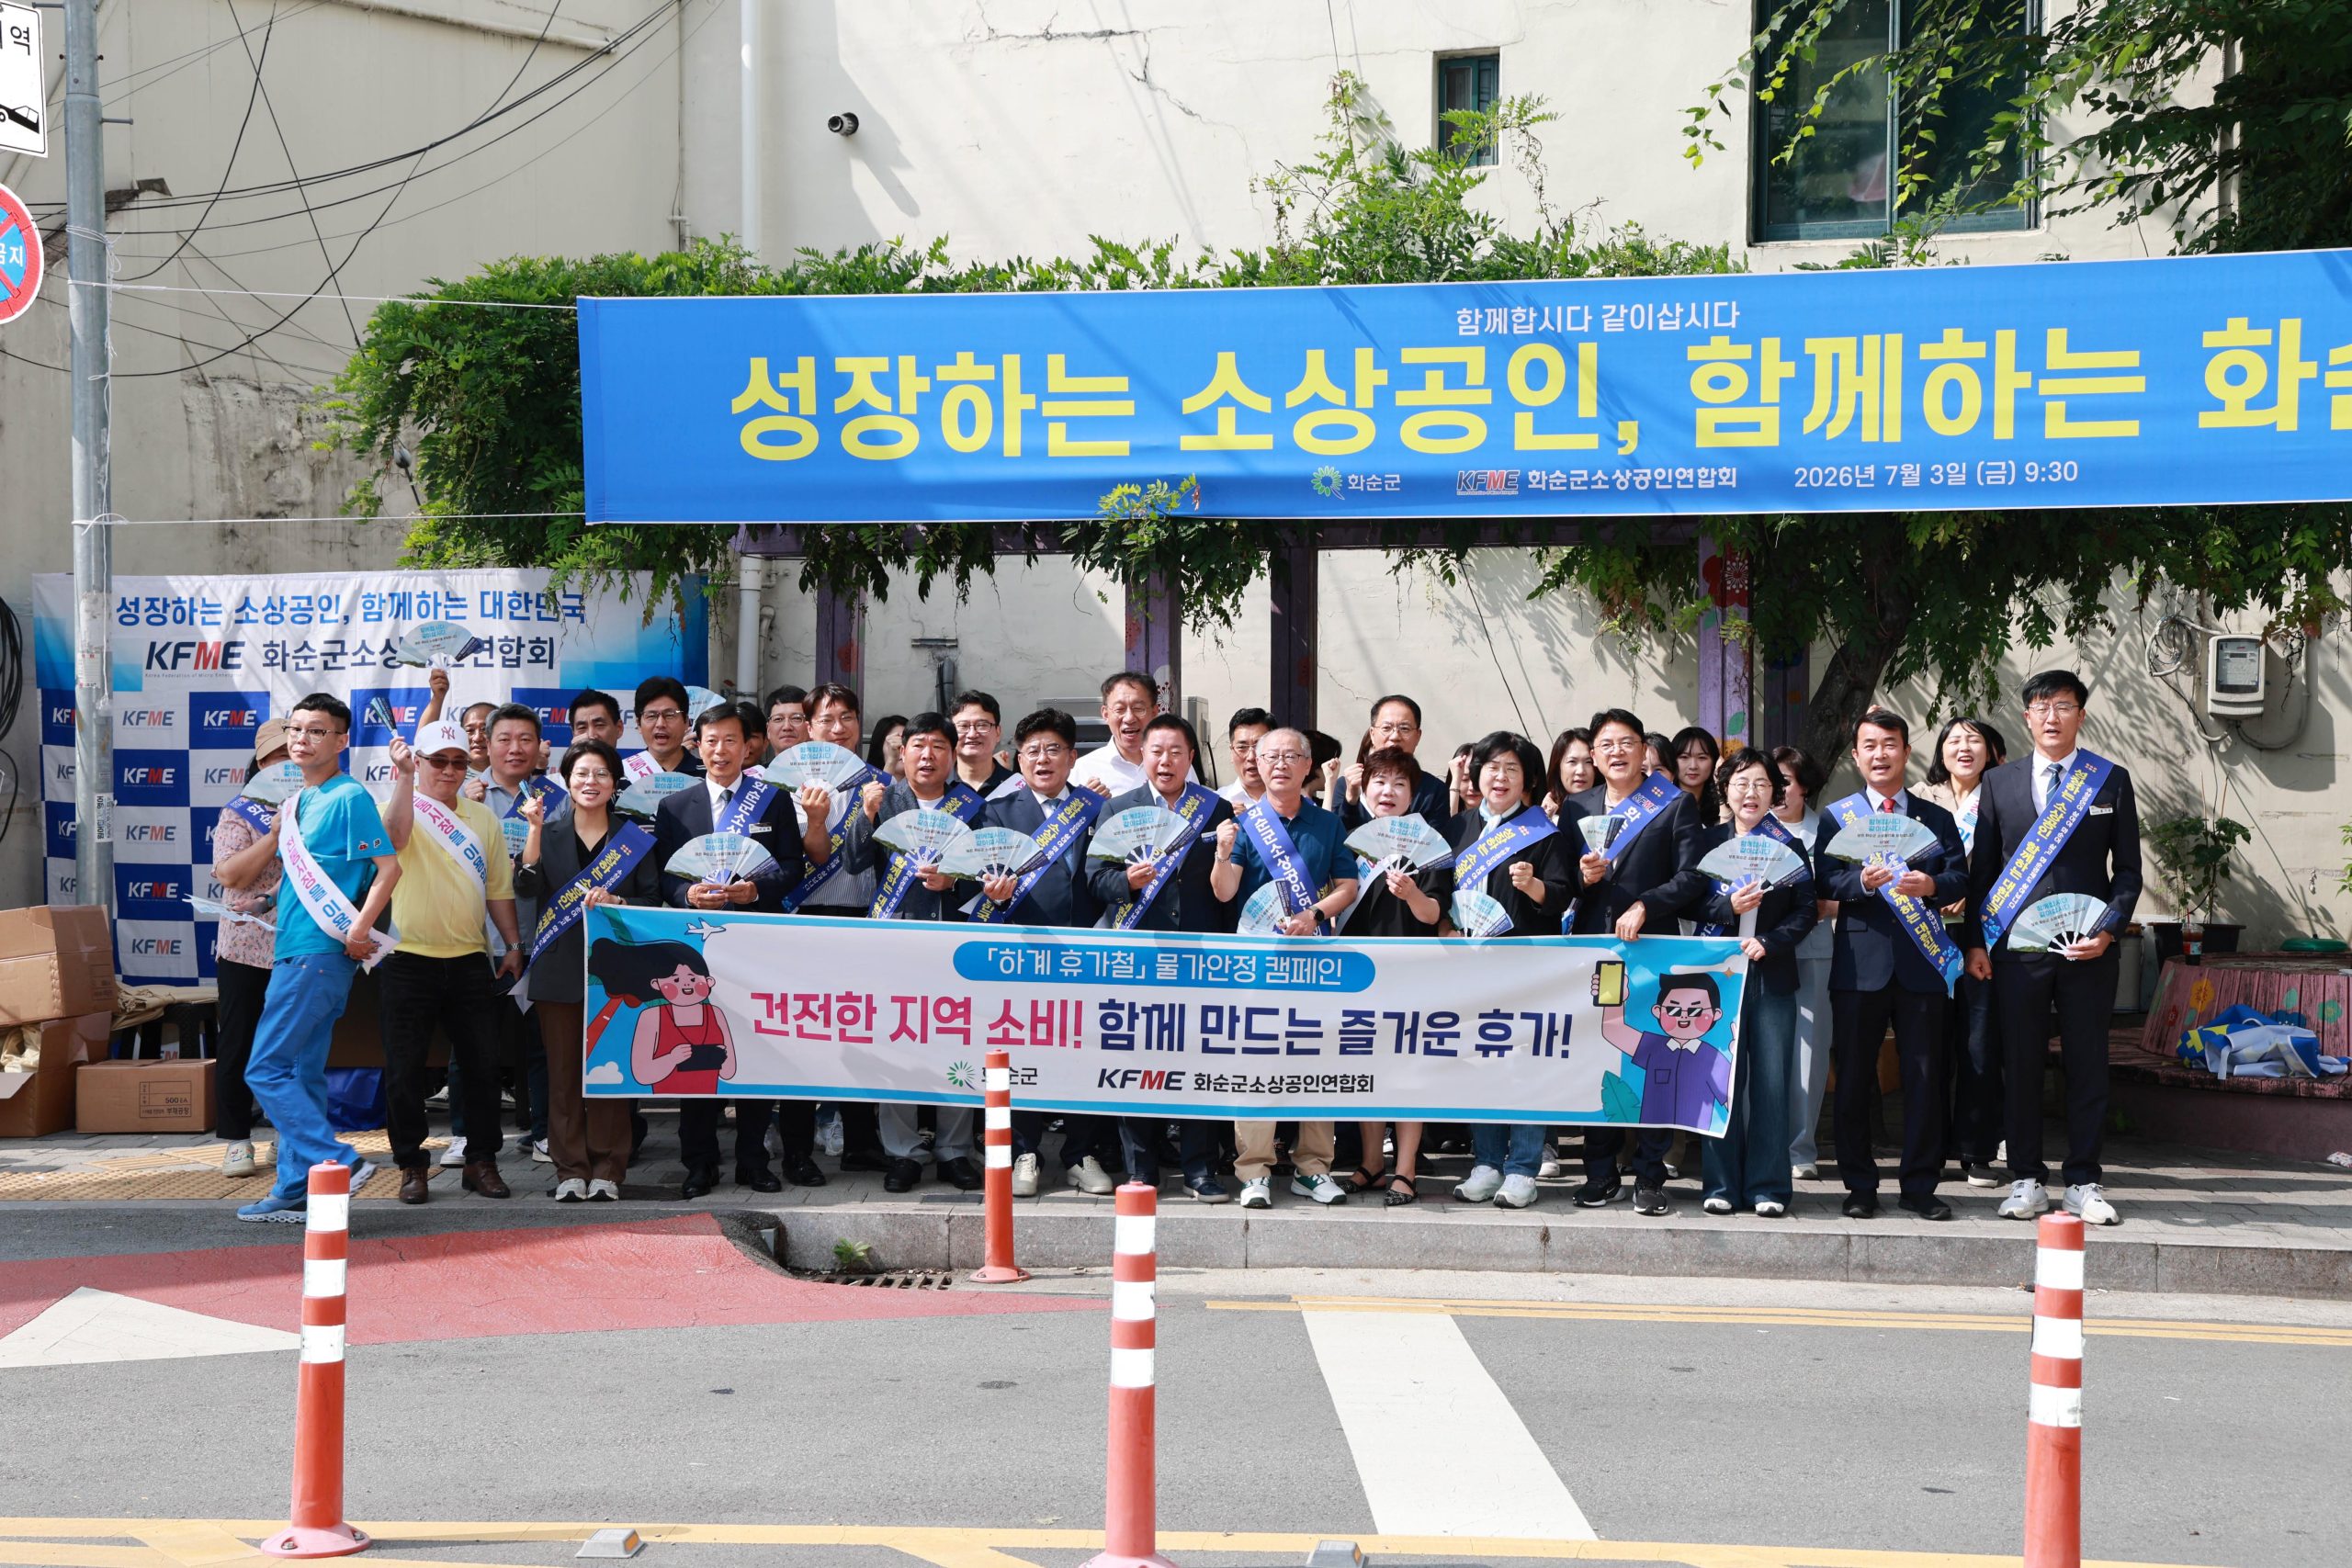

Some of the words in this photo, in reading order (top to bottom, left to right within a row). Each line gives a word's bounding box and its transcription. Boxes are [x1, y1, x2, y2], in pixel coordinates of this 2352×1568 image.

[1456, 304, 1592, 336] 함께합시다
[1601, 299, 1740, 333] 같이삽시다
[731, 351, 1136, 461] 성장하는
[1180, 342, 1640, 456] 소상공인,
[1687, 327, 2146, 447] 함께하는
[2198, 317, 2352, 432] 화
[1348, 474, 1400, 491] 화순군
[1456, 469, 1521, 491] KFME
[1528, 467, 1736, 491] 화순군소상공인연합회
[1794, 465, 1875, 488] 2026년
[1885, 463, 1921, 487] 7월
[1930, 462, 1968, 486] 3일
[1976, 460, 2016, 486] (금)
[2025, 461, 2078, 482] 9:30
[117, 596, 223, 626] 성장하는
[234, 593, 349, 626] 소상공인,
[361, 590, 468, 624] 함께하는
[145, 641, 245, 671] KFME
[262, 636, 556, 672] 화순군소상연합회
[52, 707, 75, 724] KF
[122, 710, 175, 727] KFME
[204, 709, 255, 727] KFME
[364, 706, 417, 724] KME
[57, 763, 75, 780] KF
[123, 767, 175, 784] KFME
[2058, 766, 2090, 803] 성장하는
[1056, 795, 1085, 826] 성장하는
[2034, 798, 2070, 840] 소상공인
[59, 820, 76, 836] KF
[126, 825, 176, 841] KFME
[1034, 819, 1062, 850] 소상공
[1476, 822, 1516, 859] 성장하는
[589, 847, 622, 881] 성장하는
[875, 854, 911, 895] 함께하는
[2006, 839, 2041, 881] 함께하는
[61, 876, 76, 892] KF
[128, 882, 178, 898] KFME
[1984, 877, 2016, 916] 대한민국
[322, 900, 353, 935] 이용
[865, 893, 890, 920] 대한민
[132, 939, 182, 955] KFME
[1910, 920, 1945, 958] 대한민국
[988, 949, 1051, 976] 「하계
[1155, 953, 1257, 983] 물가안정
[1265, 955, 1341, 986] 캠페인
[750, 991, 877, 1043] 건전한
[889, 995, 972, 1045] 지역
[987, 998, 1082, 1049] 소비!
[1098, 998, 1185, 1052] 함께
[1200, 1003, 1324, 1055] 만드는
[1339, 1008, 1461, 1057] 즐거운
[1474, 1008, 1572, 1059] 휴가!
[1097, 1068, 1186, 1091] KFME
[1193, 1072, 1374, 1094] 화순군소상공인연합회
